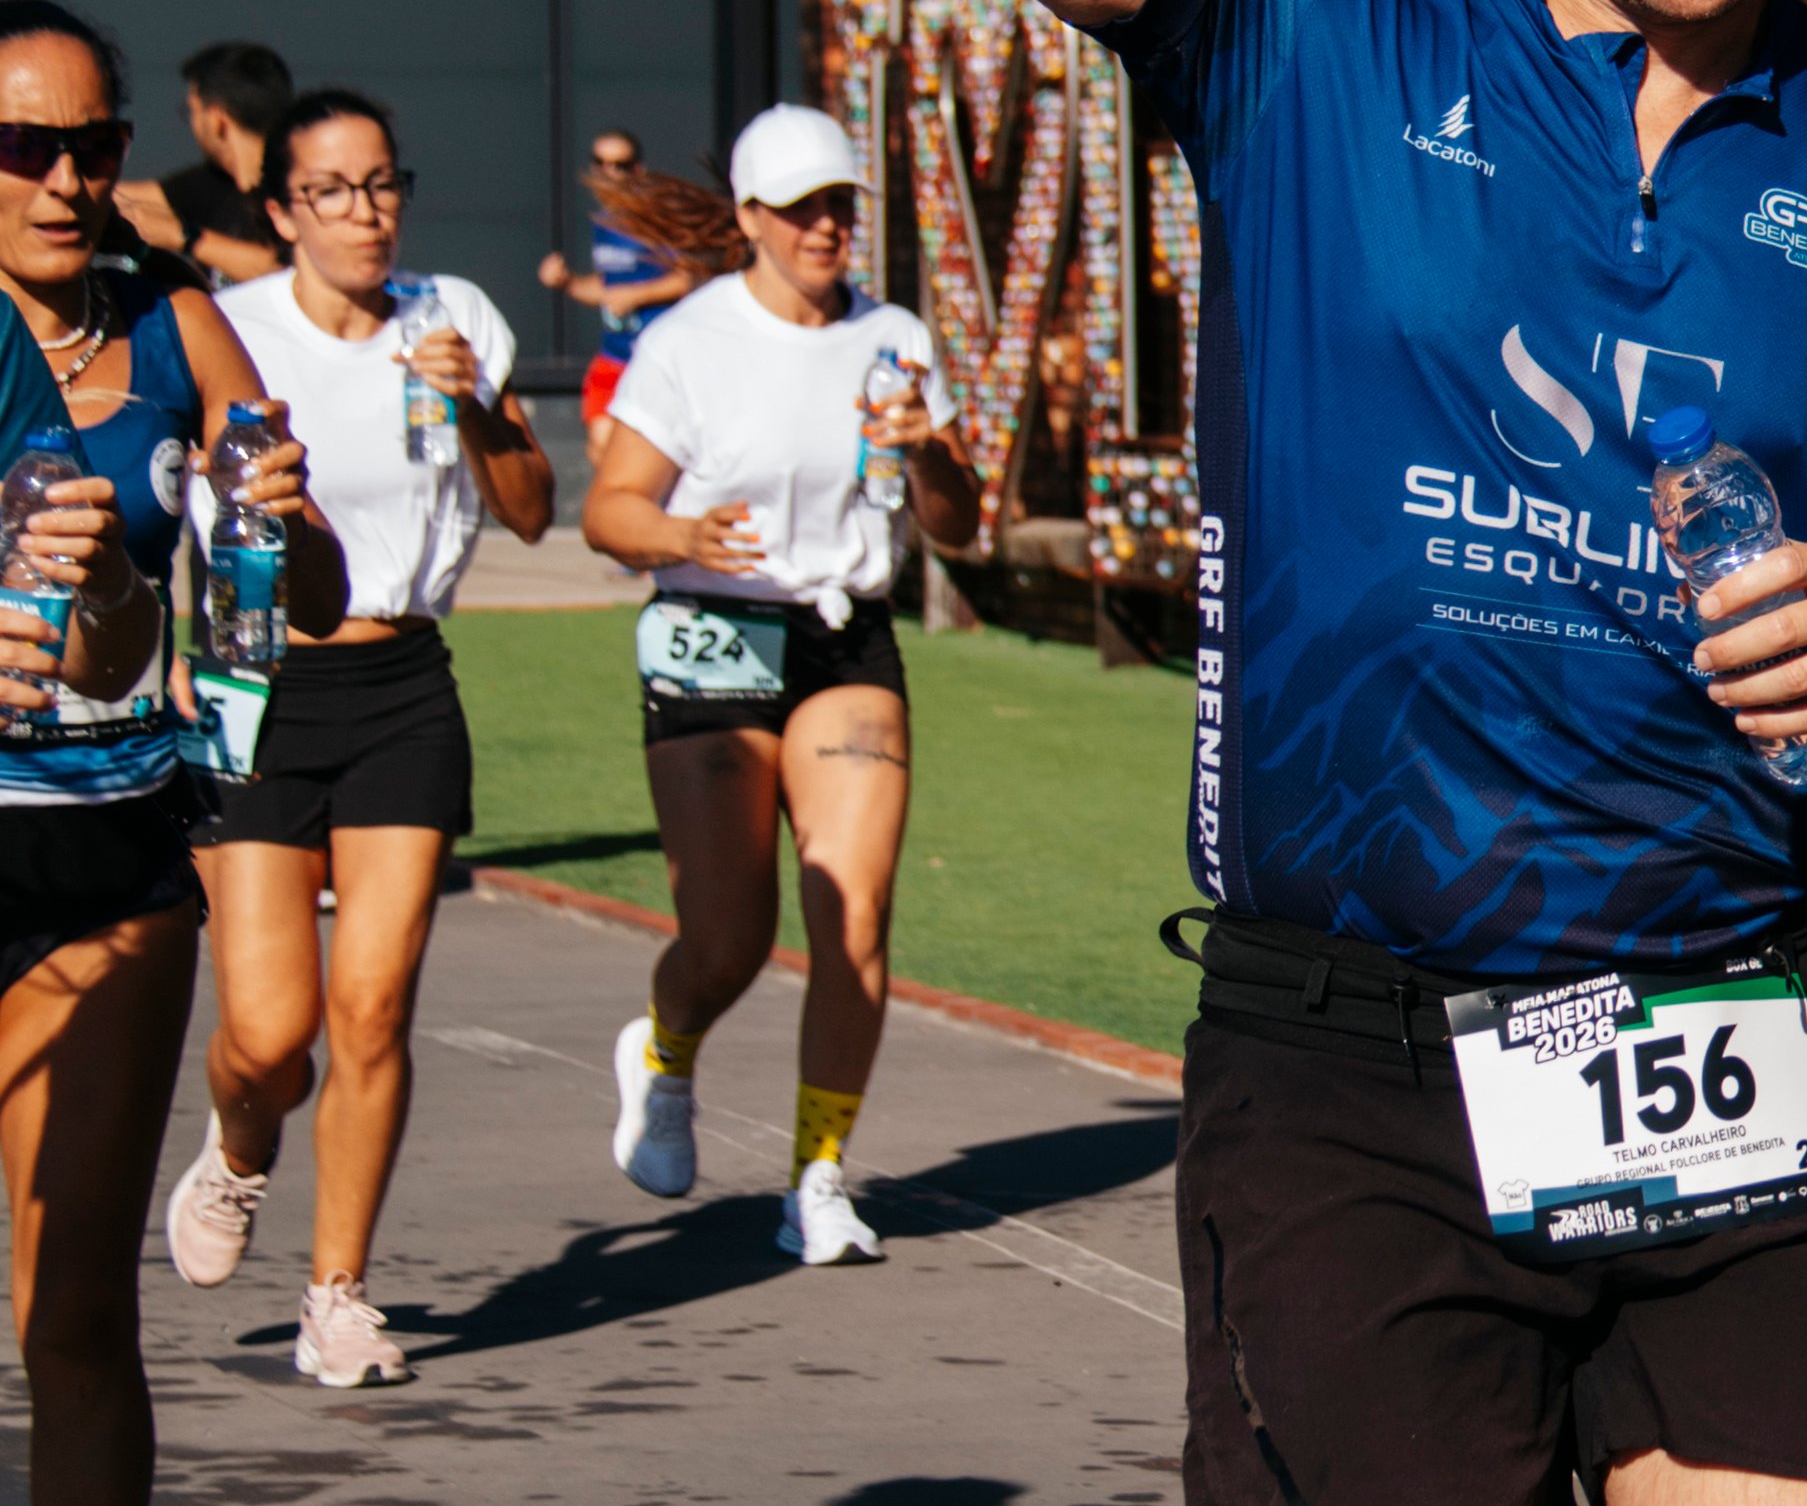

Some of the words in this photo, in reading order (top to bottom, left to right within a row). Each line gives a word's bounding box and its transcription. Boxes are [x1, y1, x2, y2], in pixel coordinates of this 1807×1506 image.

[1402, 123, 1495, 178] Lacatoni
[1402, 464, 1690, 581] SUBLI
[1197, 514, 1226, 634] GRF
[669, 624, 745, 663] 524
[1432, 603, 1558, 635] SOLUÇÕES
[1564, 623, 1598, 640] EM
[1195, 646, 1228, 904] BENEDIT
[1507, 985, 1636, 1043] BENEDITA
[1534, 1014, 1619, 1065] 2026
[1578, 1023, 1757, 1147] 156
[1576, 1173, 1612, 1190] GRUPO
[1615, 1161, 1667, 1182] REGIONAL
[1669, 1149, 1722, 1170] FOLCLORE
[1724, 1146, 1738, 1160] DE
[1740, 1137, 1786, 1157] BENEDITA
[1612, 1143, 1657, 1164] TELMO
[1660, 1124, 1747, 1154] CARVALHEIRO
[1548, 1206, 1638, 1243] WARRIORS
[1577, 1200, 1611, 1219] ROAD
